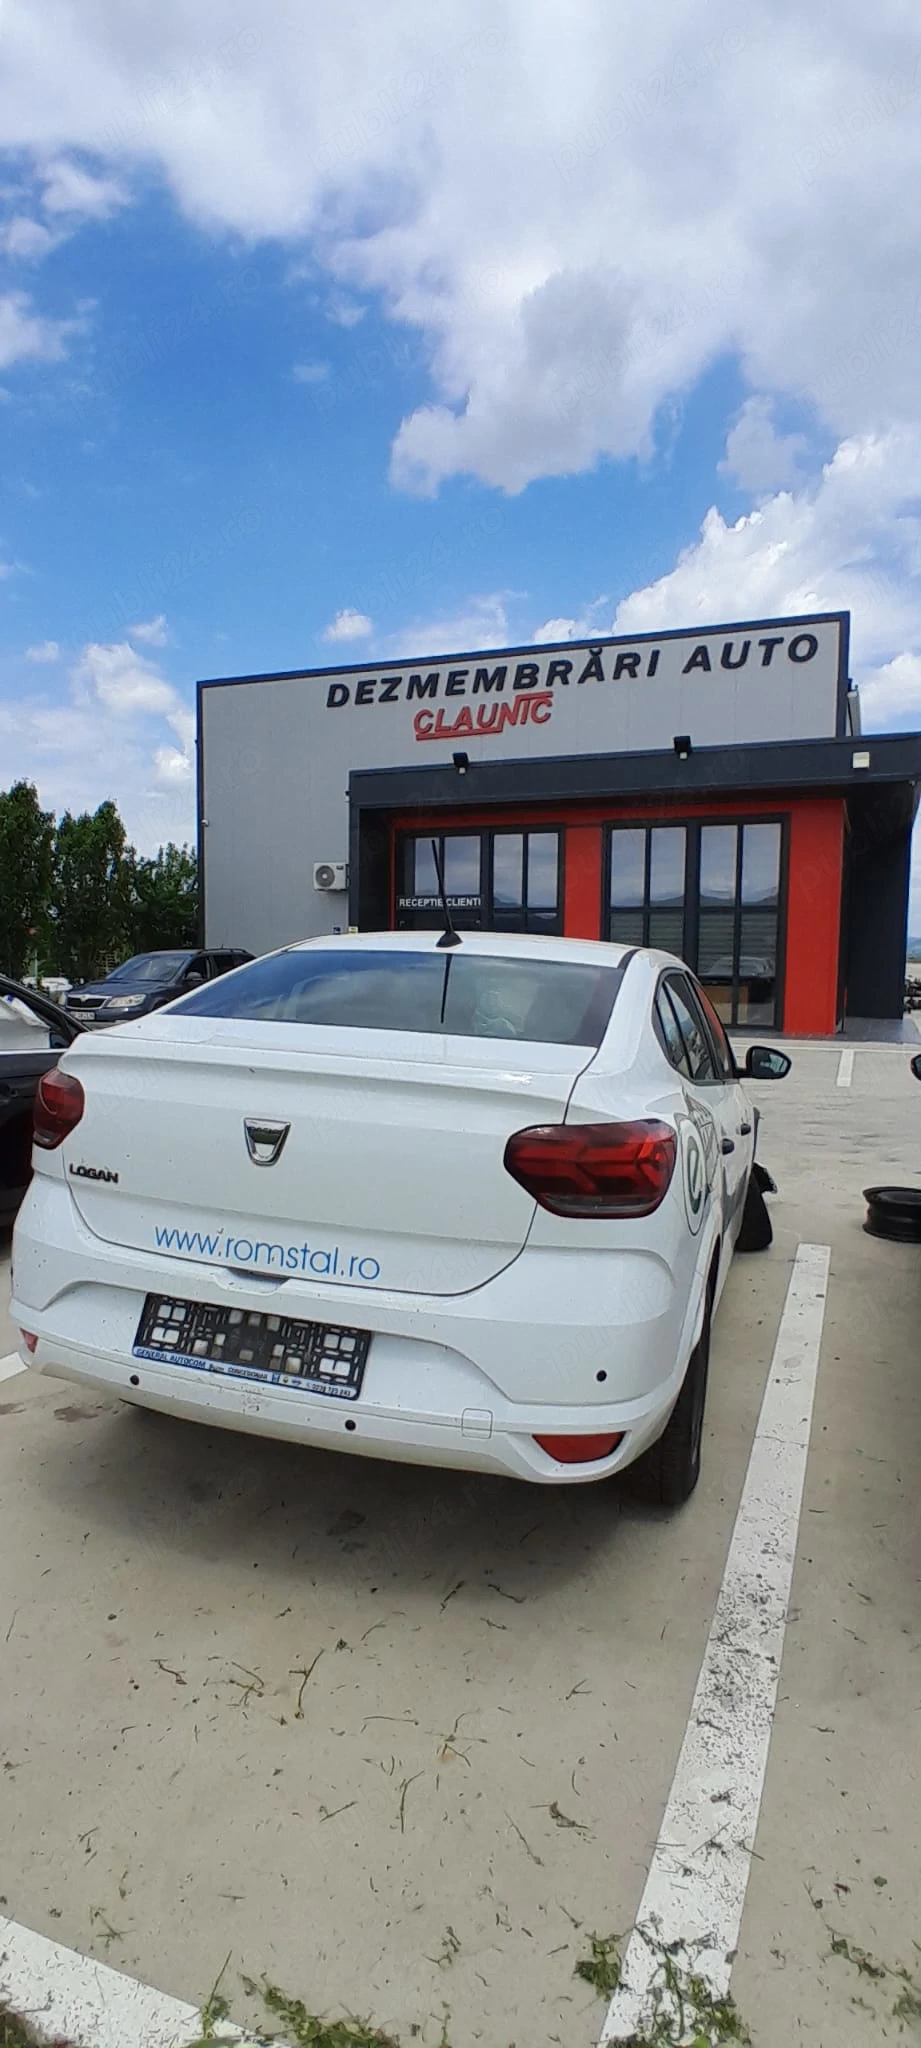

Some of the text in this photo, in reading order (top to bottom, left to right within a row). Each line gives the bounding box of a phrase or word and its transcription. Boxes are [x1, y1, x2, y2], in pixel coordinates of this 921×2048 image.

[327, 632, 820, 707] DEZMEMBRĂRI AUTO
[414, 691, 554, 740] CLAUNIC
[399, 897, 444, 907] RECEPTIE
[69, 1163, 119, 1184] LOGAN
[155, 1225, 381, 1281] www.romstal.ro
